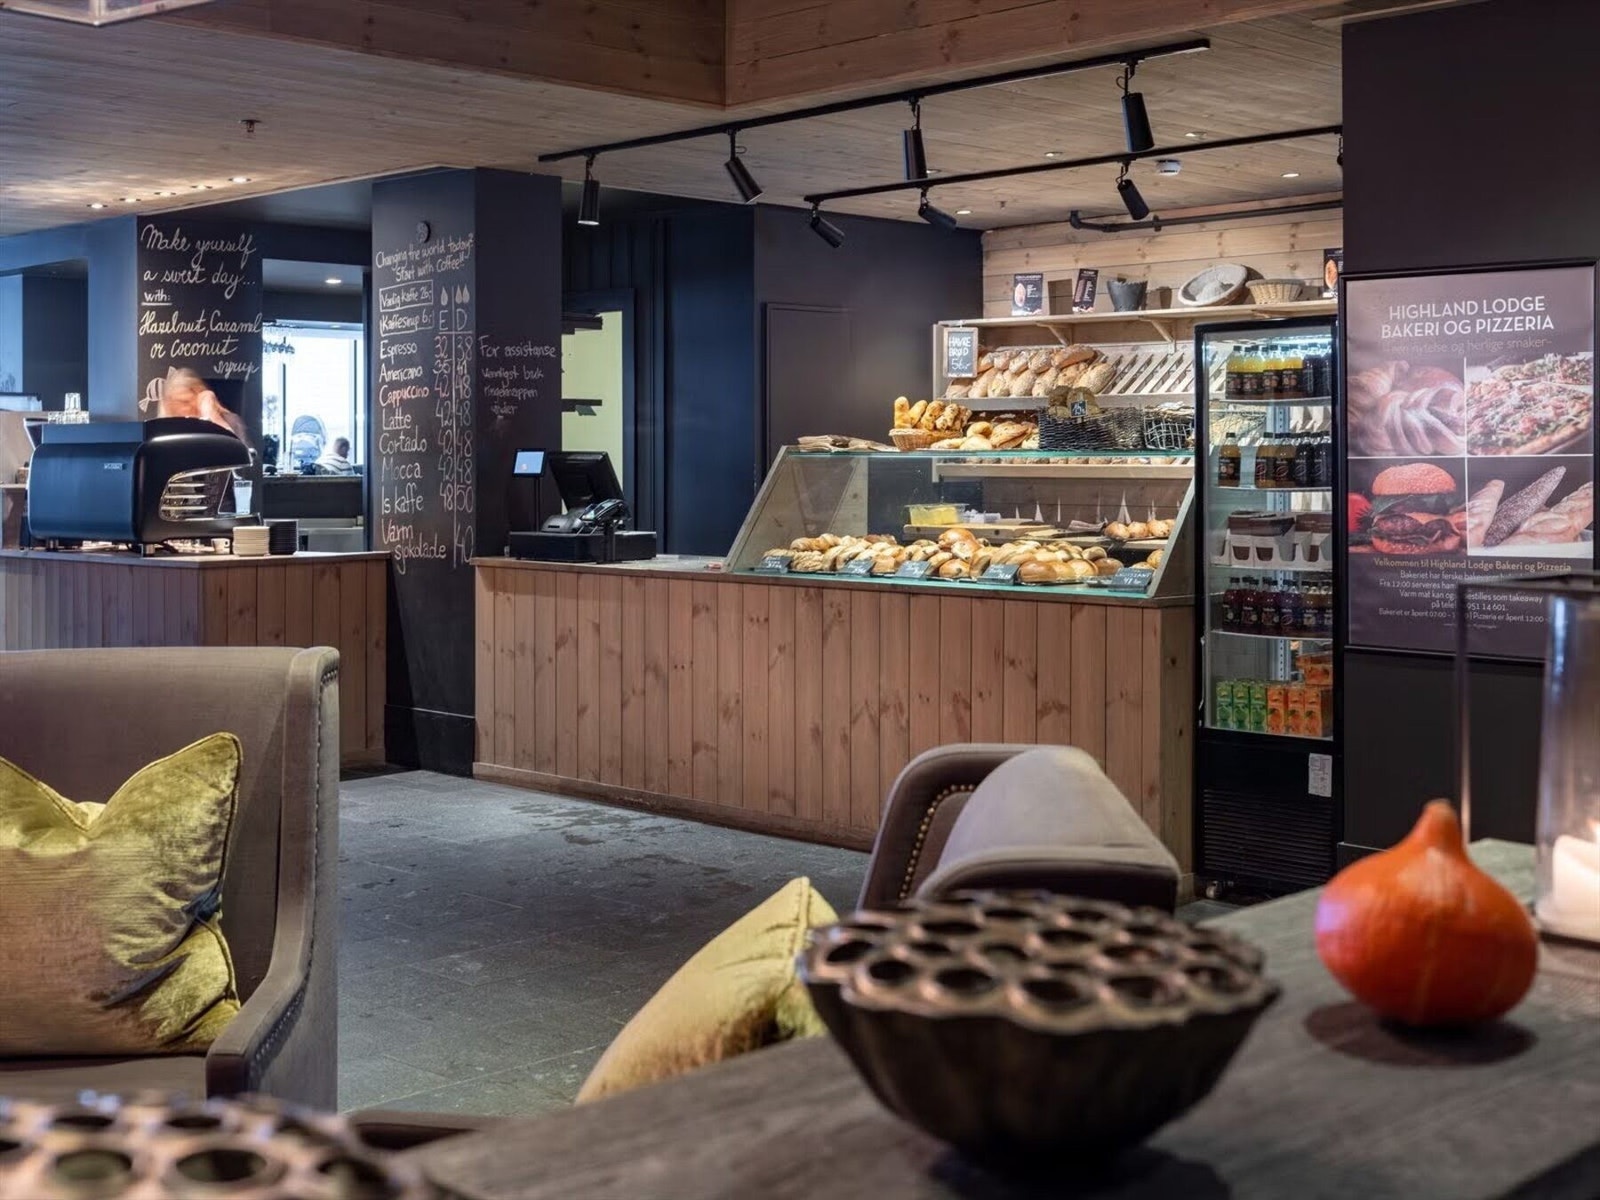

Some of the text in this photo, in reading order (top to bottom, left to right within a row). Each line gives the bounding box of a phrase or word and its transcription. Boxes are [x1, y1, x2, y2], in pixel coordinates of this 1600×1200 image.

[141, 224, 256, 269] Make yourself
[375, 248, 408, 271] Changing
[408, 243, 420, 260] the
[421, 239, 445, 257] world
[143, 269, 158, 281] a
[161, 265, 206, 284] sweet
[395, 264, 415, 282] Start
[417, 258, 434, 277] with
[439, 308, 468, 331] E D
[1388, 295, 1546, 320] HIGHLAND LODGE
[210, 310, 263, 334] Caramel
[1381, 314, 1554, 338] BAKERI OG PIZZERIA
[150, 344, 167, 359] or
[380, 335, 473, 365] Espresso 32 38
[478, 334, 556, 358] For assistanse
[1451, 343, 1464, 354] og
[1467, 338, 1504, 353] herlige
[213, 360, 259, 382] syrup
[379, 362, 423, 383] Americano
[379, 373, 471, 409] Cappuccino 42 48
[382, 398, 471, 431] Latte 42 48
[379, 425, 473, 458] Cortado 42 48
[381, 454, 473, 485] Mocca 42 48
[439, 481, 454, 513] 48
[456, 485, 474, 514] 50
[381, 518, 414, 545] Varm
[394, 532, 447, 576] sjokolade
[1374, 557, 1572, 572] Velkommen til Highland Lodge Bakeri og Pizzeria
[1429, 570, 1441, 579] har
[1399, 589, 1417, 598] Varm
[1432, 590, 1444, 599] kan
[1465, 591, 1492, 601] estilles
[1509, 593, 1543, 604] takeaway
